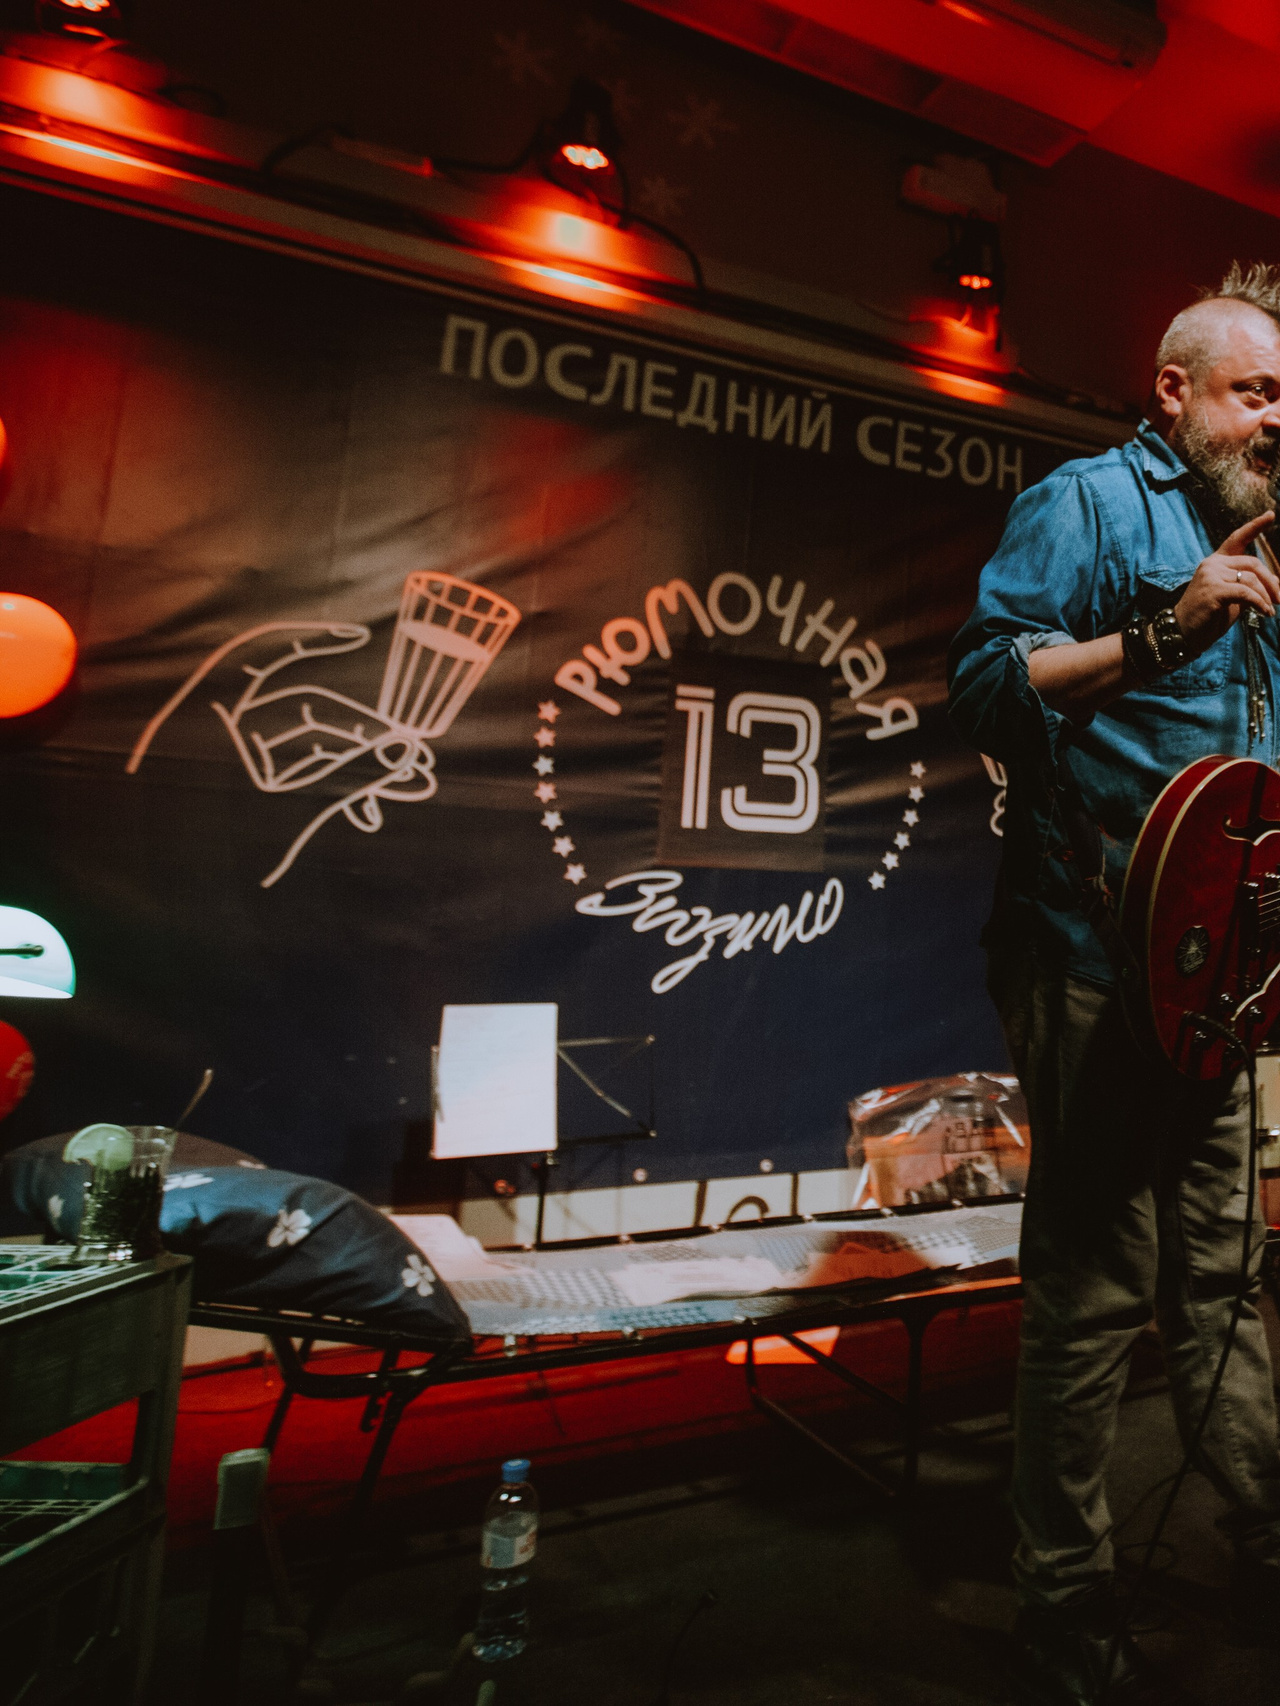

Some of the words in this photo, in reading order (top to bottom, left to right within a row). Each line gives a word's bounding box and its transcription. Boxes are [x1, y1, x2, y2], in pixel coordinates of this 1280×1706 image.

[439, 313, 832, 453] ПОСЛЕДНИЙ
[856, 414, 1024, 492] СЕЗОН
[675, 684, 822, 834] 13
